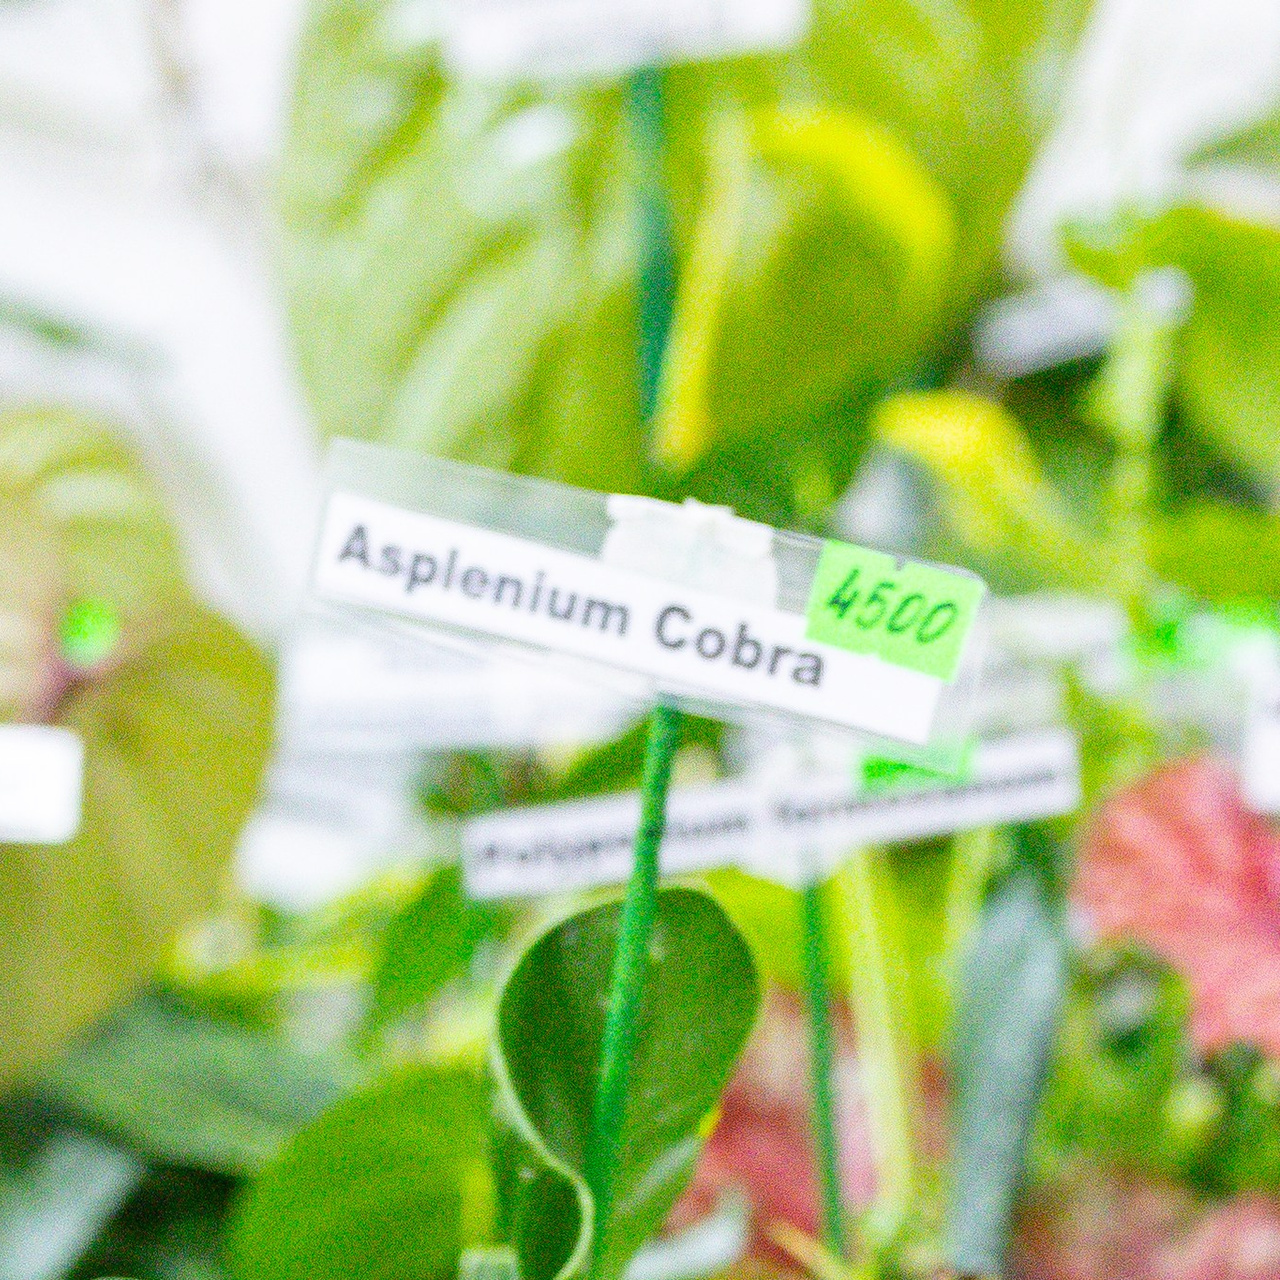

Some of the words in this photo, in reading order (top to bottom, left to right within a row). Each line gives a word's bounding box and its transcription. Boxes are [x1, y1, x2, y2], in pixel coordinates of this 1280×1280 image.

[338, 523, 631, 638] Asplenium
[654, 604, 825, 688] Cobra
[827, 568, 958, 644] 4500
